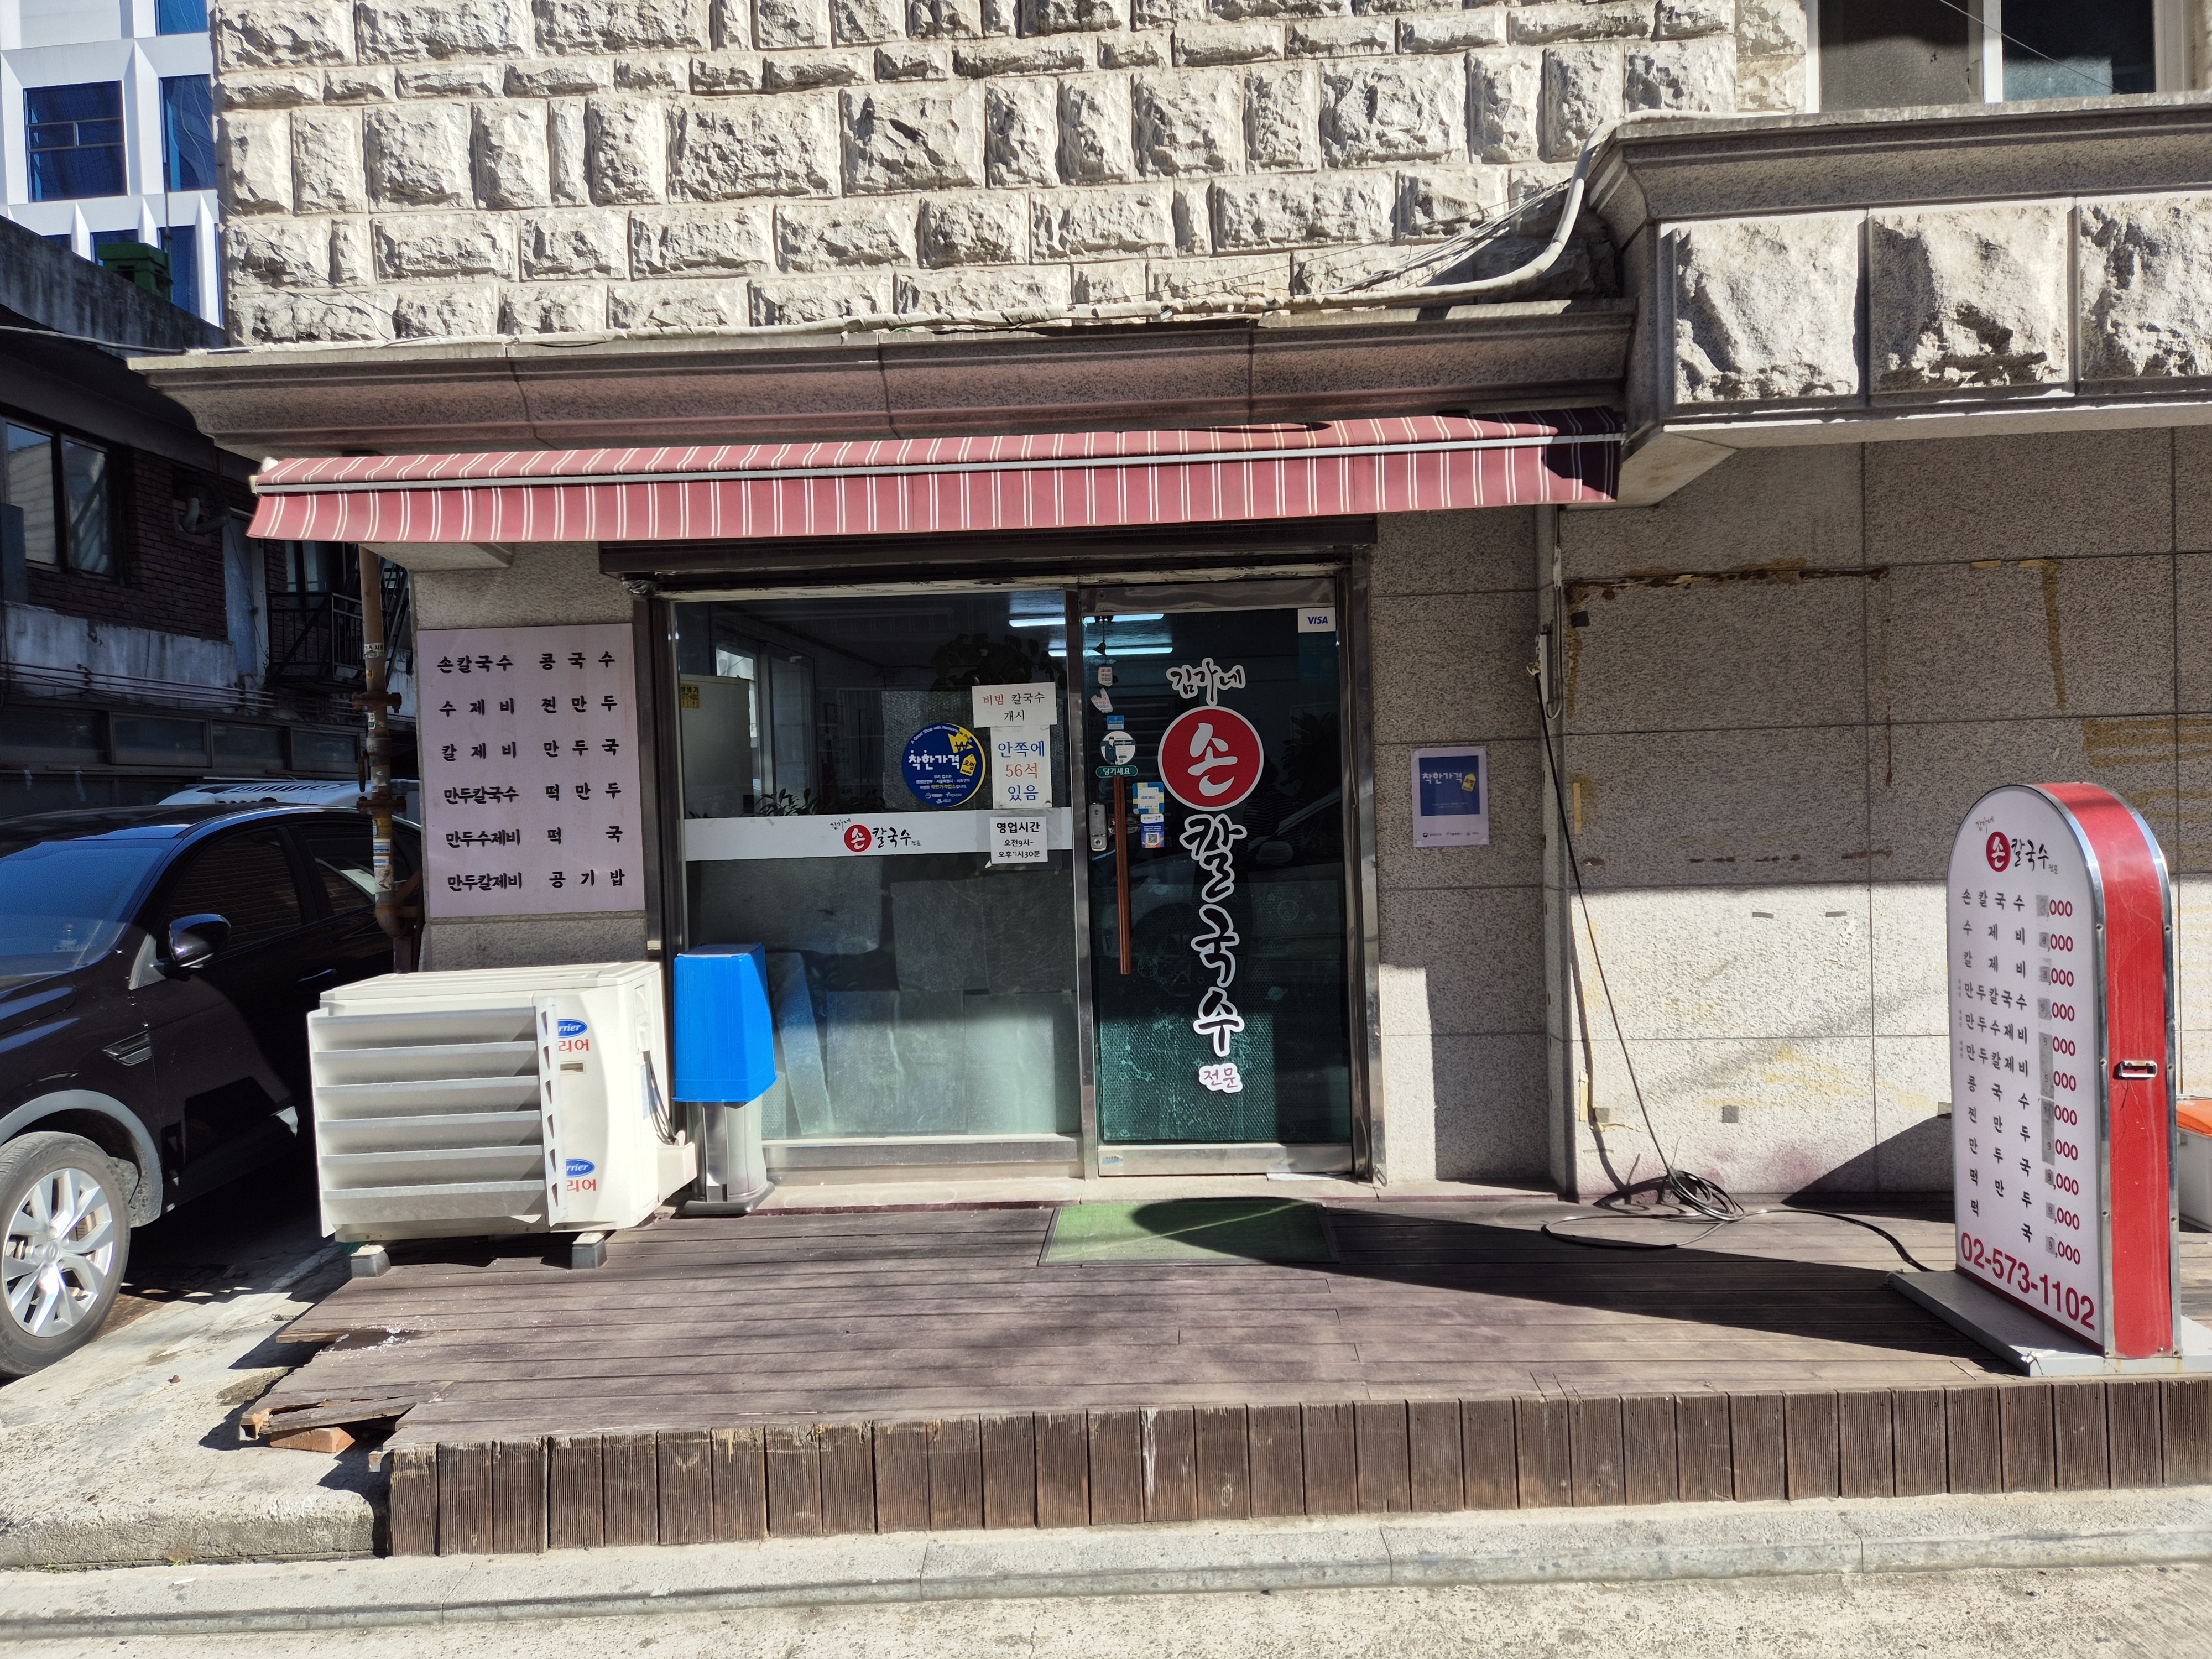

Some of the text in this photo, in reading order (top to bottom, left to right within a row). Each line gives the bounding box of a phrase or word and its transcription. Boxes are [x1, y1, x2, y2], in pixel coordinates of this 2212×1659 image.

[1306, 616, 1328, 624] VISA
[437, 654, 513, 673] 손칼국수
[1168, 660, 1244, 705] 김가네
[983, 692, 1045, 706] 비빔 칼국수
[1004, 710, 1025, 722] 개시
[914, 733, 923, 741] Good
[923, 726, 933, 734] Shop
[998, 740, 1045, 758] 안쪽에
[908, 750, 959, 770] 착한가격
[963, 760, 975, 770] 모범
[1005, 763, 1037, 779] 56석
[1422, 772, 1462, 784] 착한가격
[444, 785, 519, 804] 만두칼국수
[1008, 785, 1039, 801] 있음
[830, 818, 851, 831] 김가네
[997, 822, 1040, 833] 영업시간
[1975, 816, 1994, 833] 김가네
[446, 829, 520, 848] 만두수제비
[447, 872, 522, 891] 만두칼제비
[1962, 889, 2025, 912] 손칼국수
[1965, 982, 2027, 1011] 만두칼국수
[559, 1024, 582, 1032] rrier
[1965, 1013, 2027, 1045] 만두수제비
[559, 1039, 589, 1052] 리어
[1966, 1044, 2028, 1078] 만두칼제비
[1203, 1067, 1239, 1089] 전문
[567, 1162, 589, 1171] rrier
[567, 1179, 596, 1192] 리어
[2047, 1172, 2079, 1196] 9,000
[2048, 1207, 2080, 1230] 9,000
[2048, 1240, 2080, 1265] 9,000
[1961, 1232, 2095, 1331] 02-573-1102
